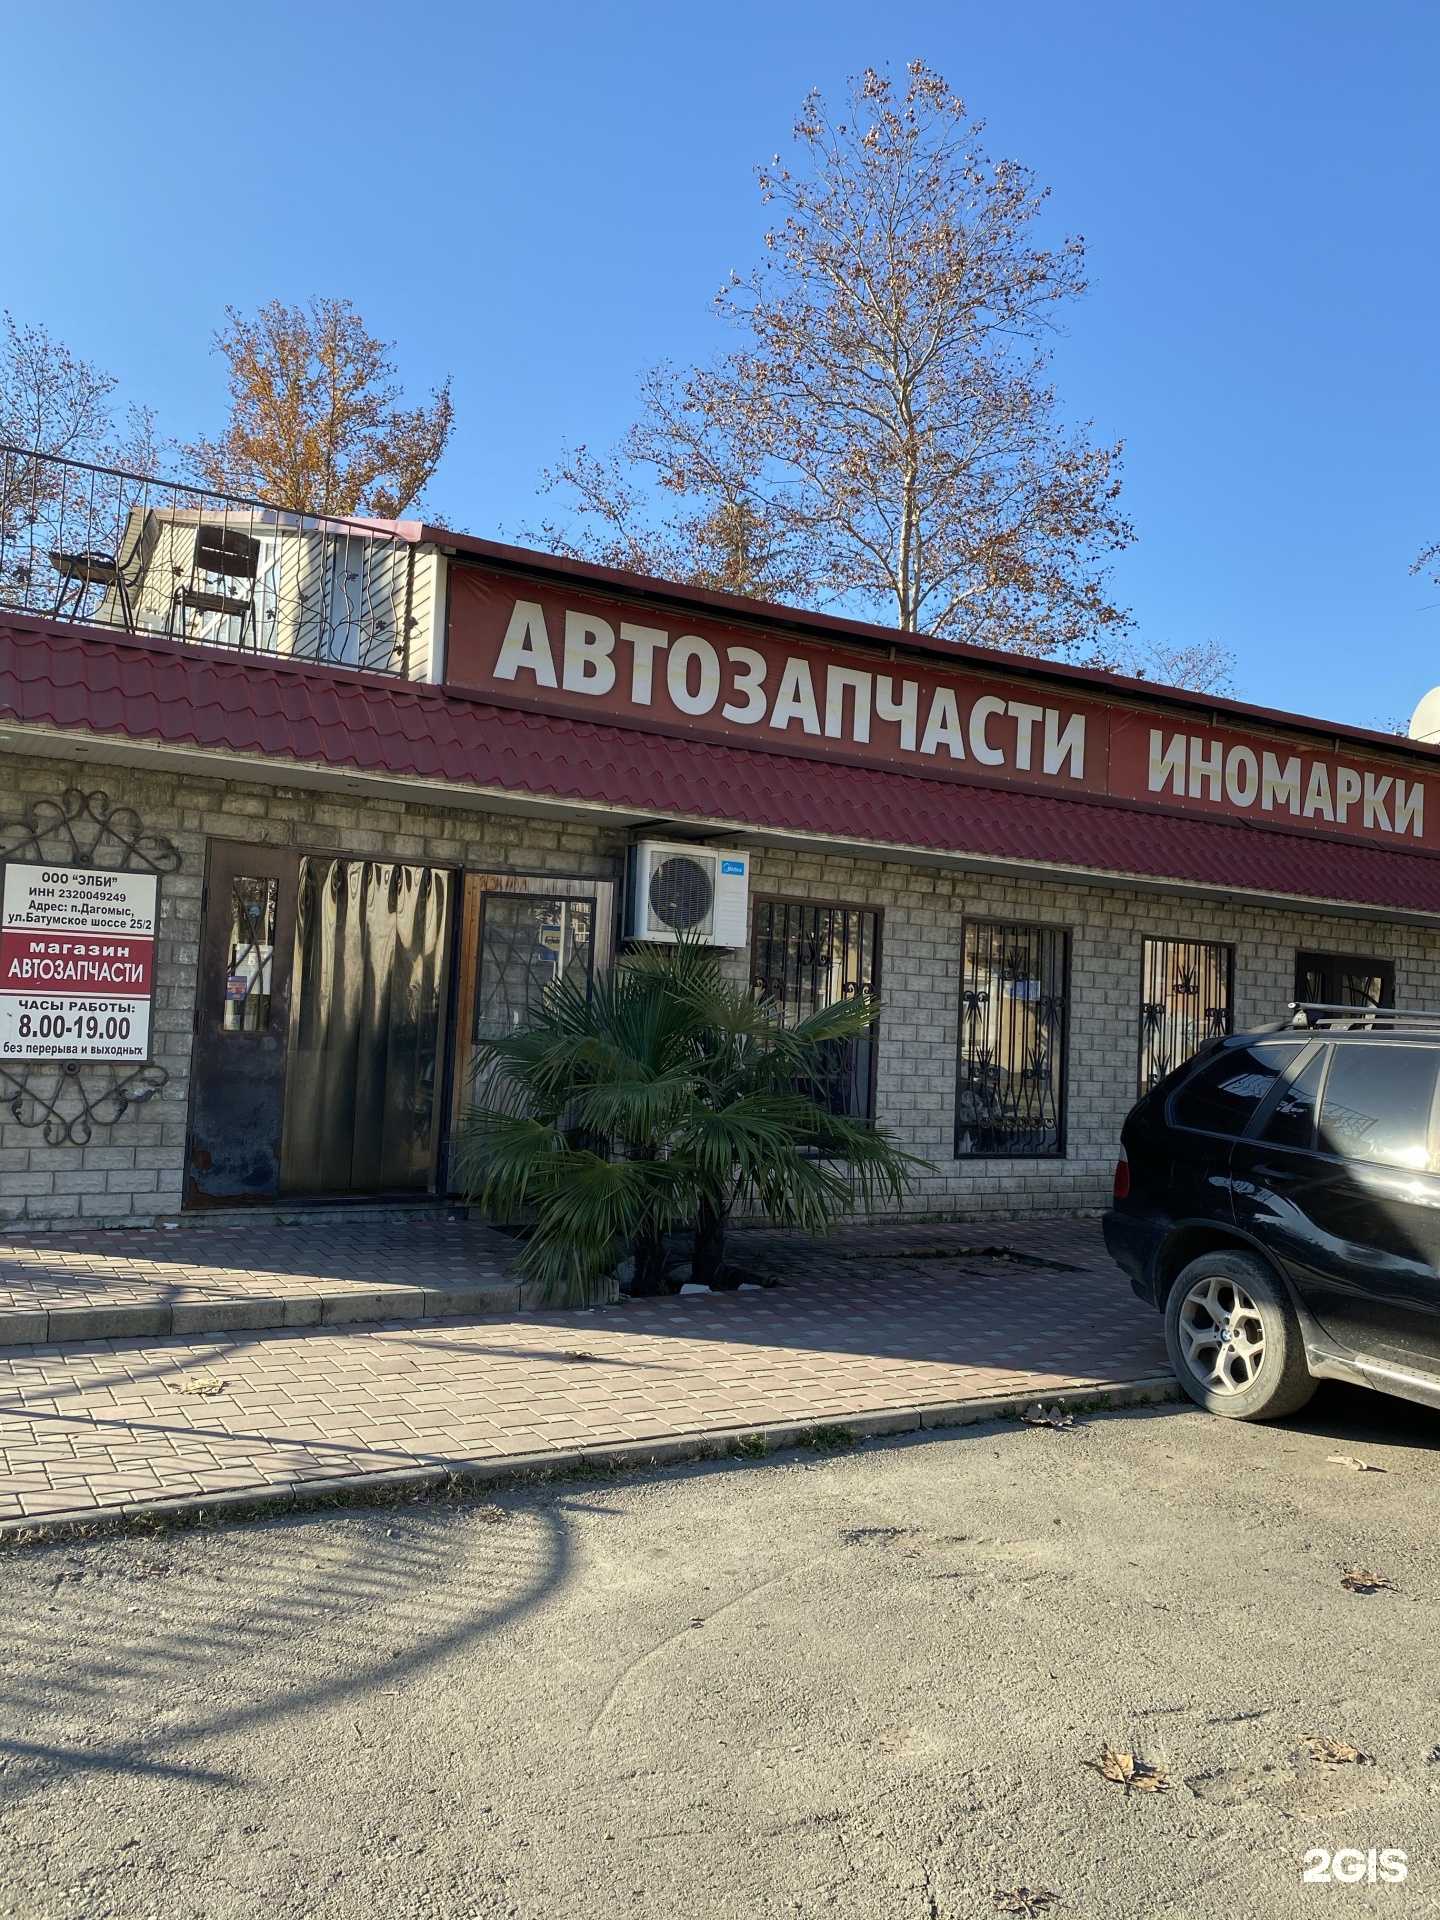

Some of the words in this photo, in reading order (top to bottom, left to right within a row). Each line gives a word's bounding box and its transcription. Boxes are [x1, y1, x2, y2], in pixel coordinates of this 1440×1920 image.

[493, 599, 1085, 779] АВТОЗАПЧАСТИ
[1148, 729, 1425, 837] ИНОМАРКИ
[42, 872, 69, 884] ООО
[29, 887, 55, 897] ИНН
[58, 888, 126, 902] 2320049249
[28, 900, 68, 912] Адрес:
[70, 903, 135, 918] п.Дагомыс,
[8, 912, 88, 926] ул.Батумское
[91, 919, 127, 928] шоссе
[129, 918, 152, 930] 25/2
[29, 942, 129, 957] магазин
[8, 958, 143, 982] АВТОЗАПЧАСТИ
[18, 1000, 63, 1011] ЧАСЫ
[69, 1001, 136, 1013] РАБОТЫ:
[19, 1014, 131, 1040] 8.00-19.00
[3, 1042, 23, 1053] без
[26, 1043, 78, 1056] перерыва
[90, 1046, 143, 1056] выходных
